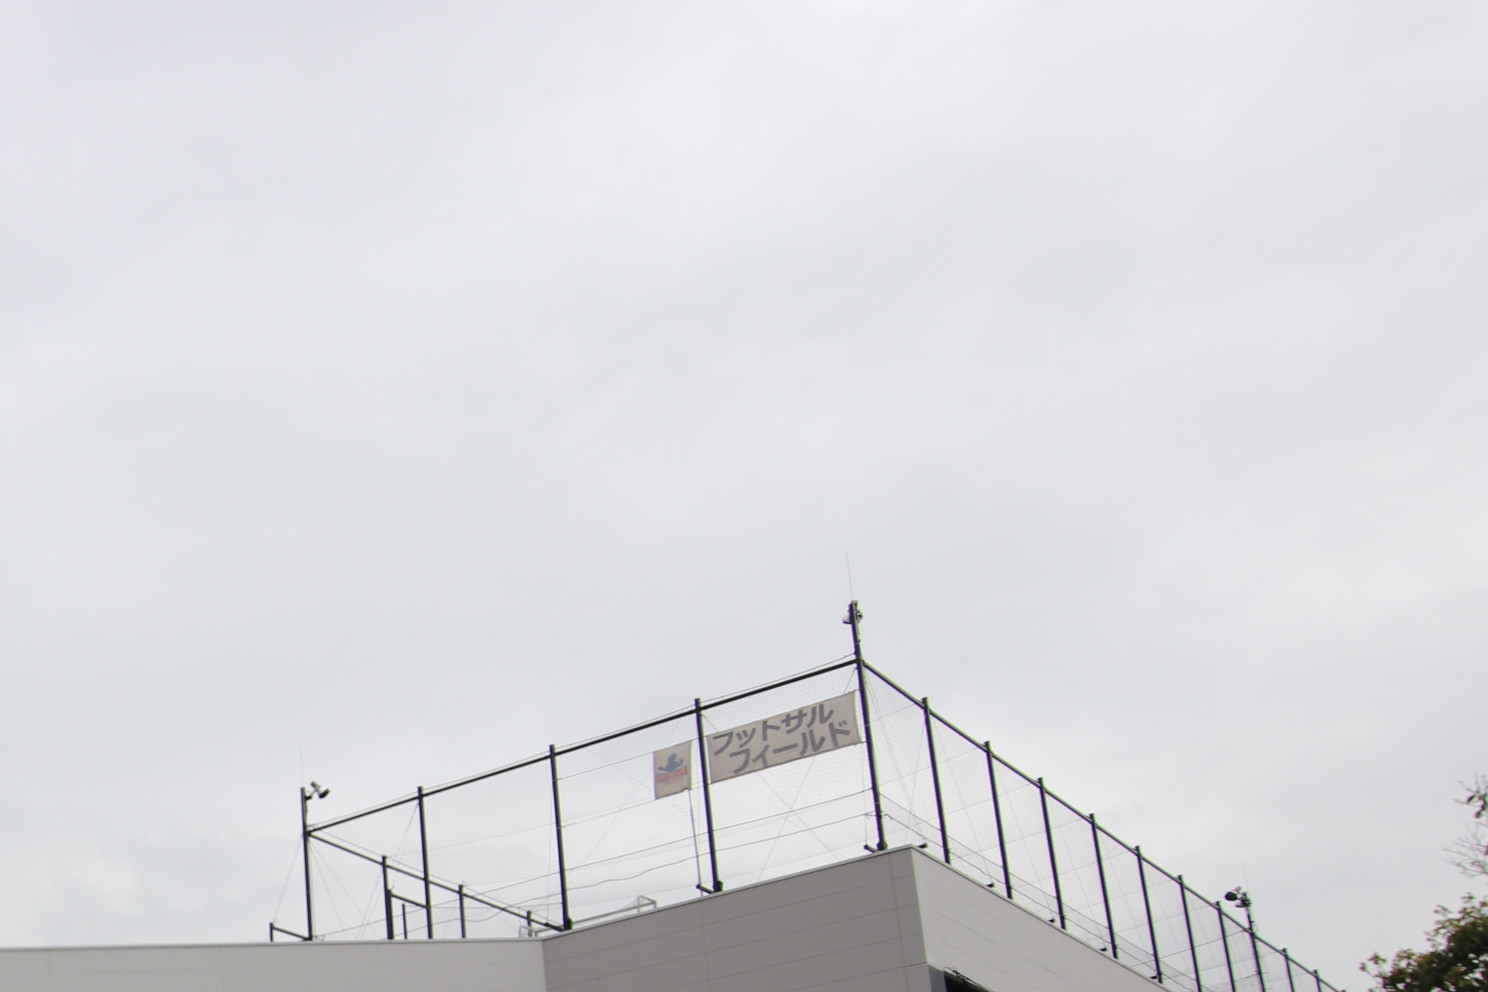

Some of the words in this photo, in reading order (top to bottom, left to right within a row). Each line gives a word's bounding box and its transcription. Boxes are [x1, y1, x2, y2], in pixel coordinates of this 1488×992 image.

[712, 703, 835, 756] フットサル
[729, 719, 851, 775] フィールド
